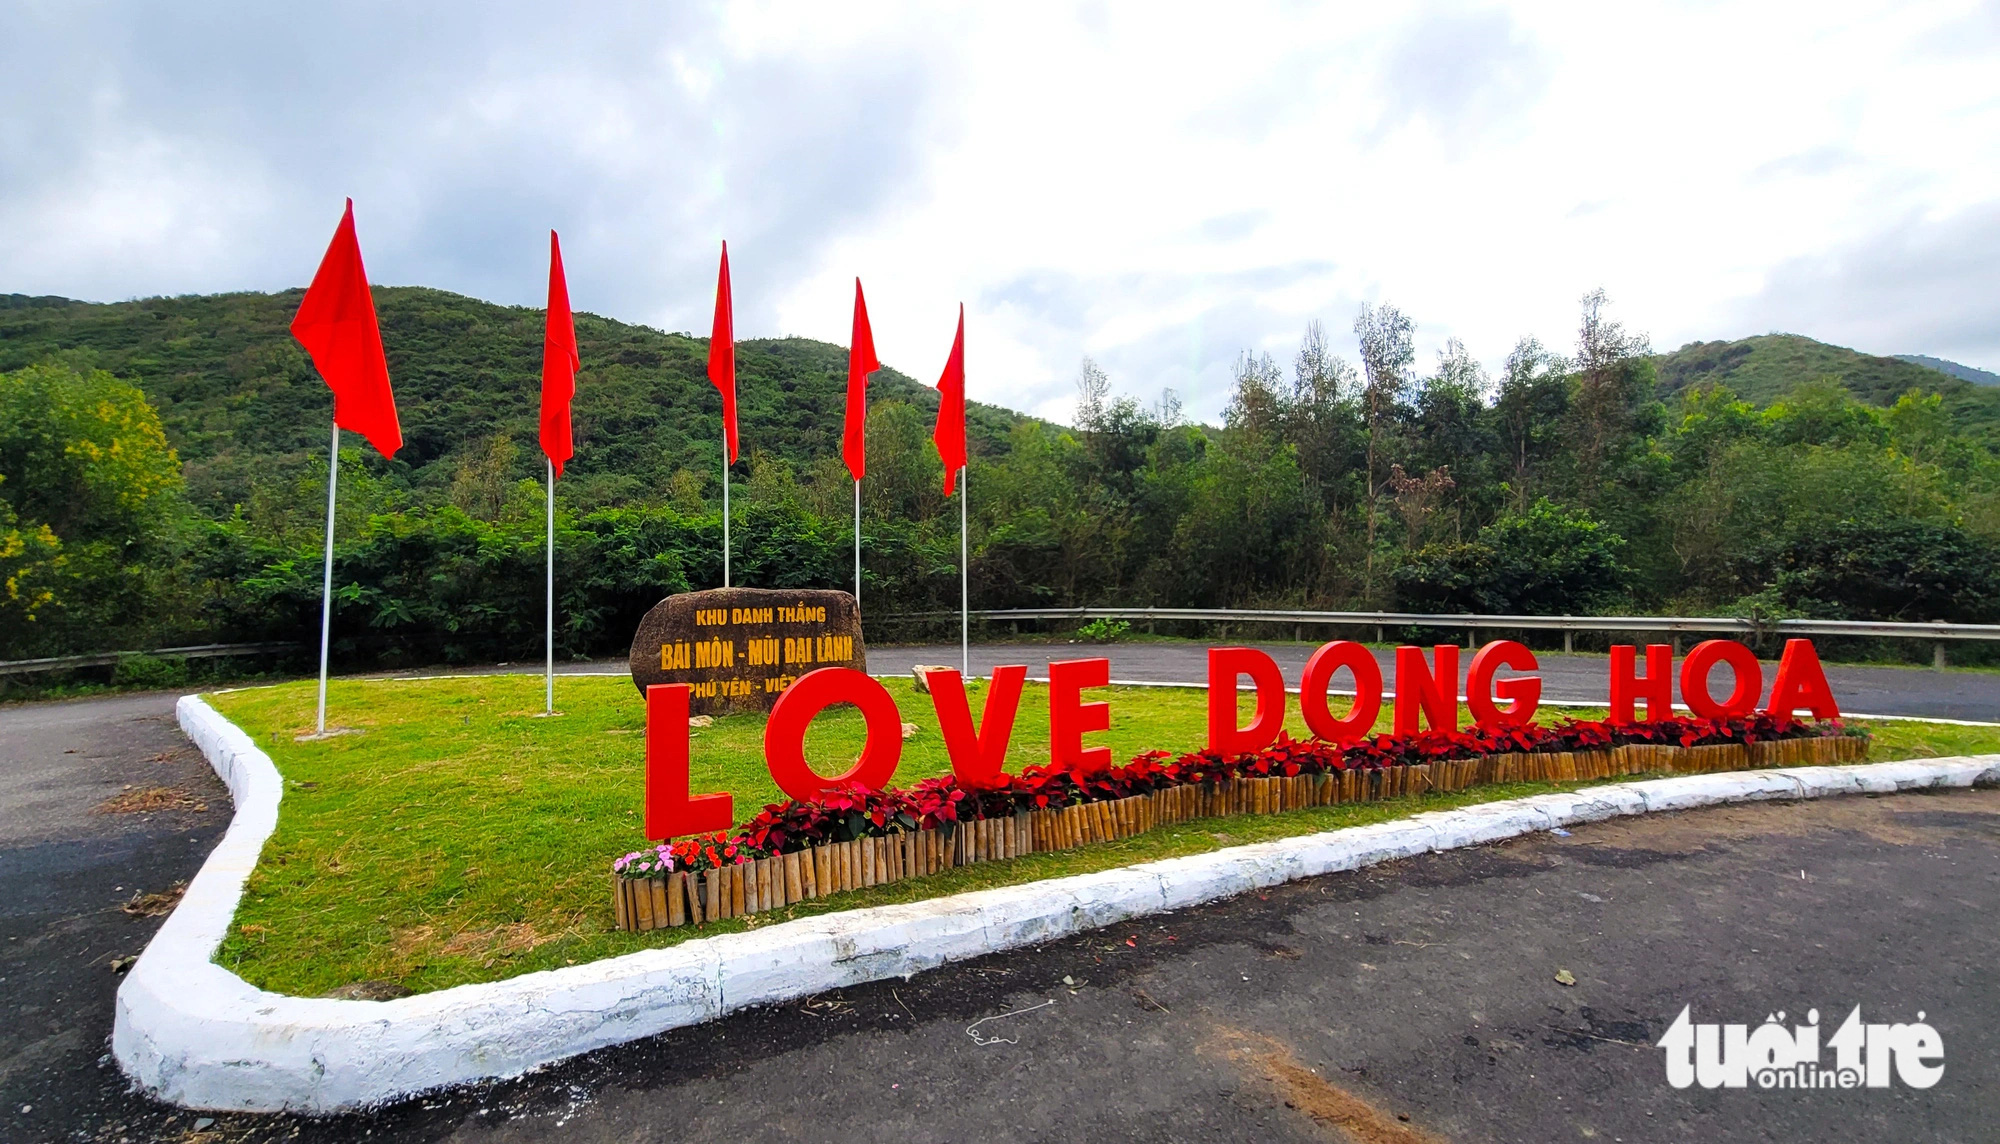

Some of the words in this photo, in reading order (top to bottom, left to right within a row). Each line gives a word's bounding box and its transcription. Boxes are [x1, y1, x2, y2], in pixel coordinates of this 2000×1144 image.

[696, 608, 728, 626] KHU
[732, 606, 773, 624] DANH
[777, 601, 826, 623] THẮNG
[661, 639, 691, 670] BÃI
[695, 636, 734, 669] MÔN
[748, 635, 780, 666] MŨI
[784, 637, 812, 669] ĐẠI
[816, 632, 853, 663] LÃNH
[721, 677, 751, 697] YÊN
[645, 657, 1111, 841] LOVE
[1208, 640, 1541, 754] DONG
[1609, 638, 1840, 724] HOA
